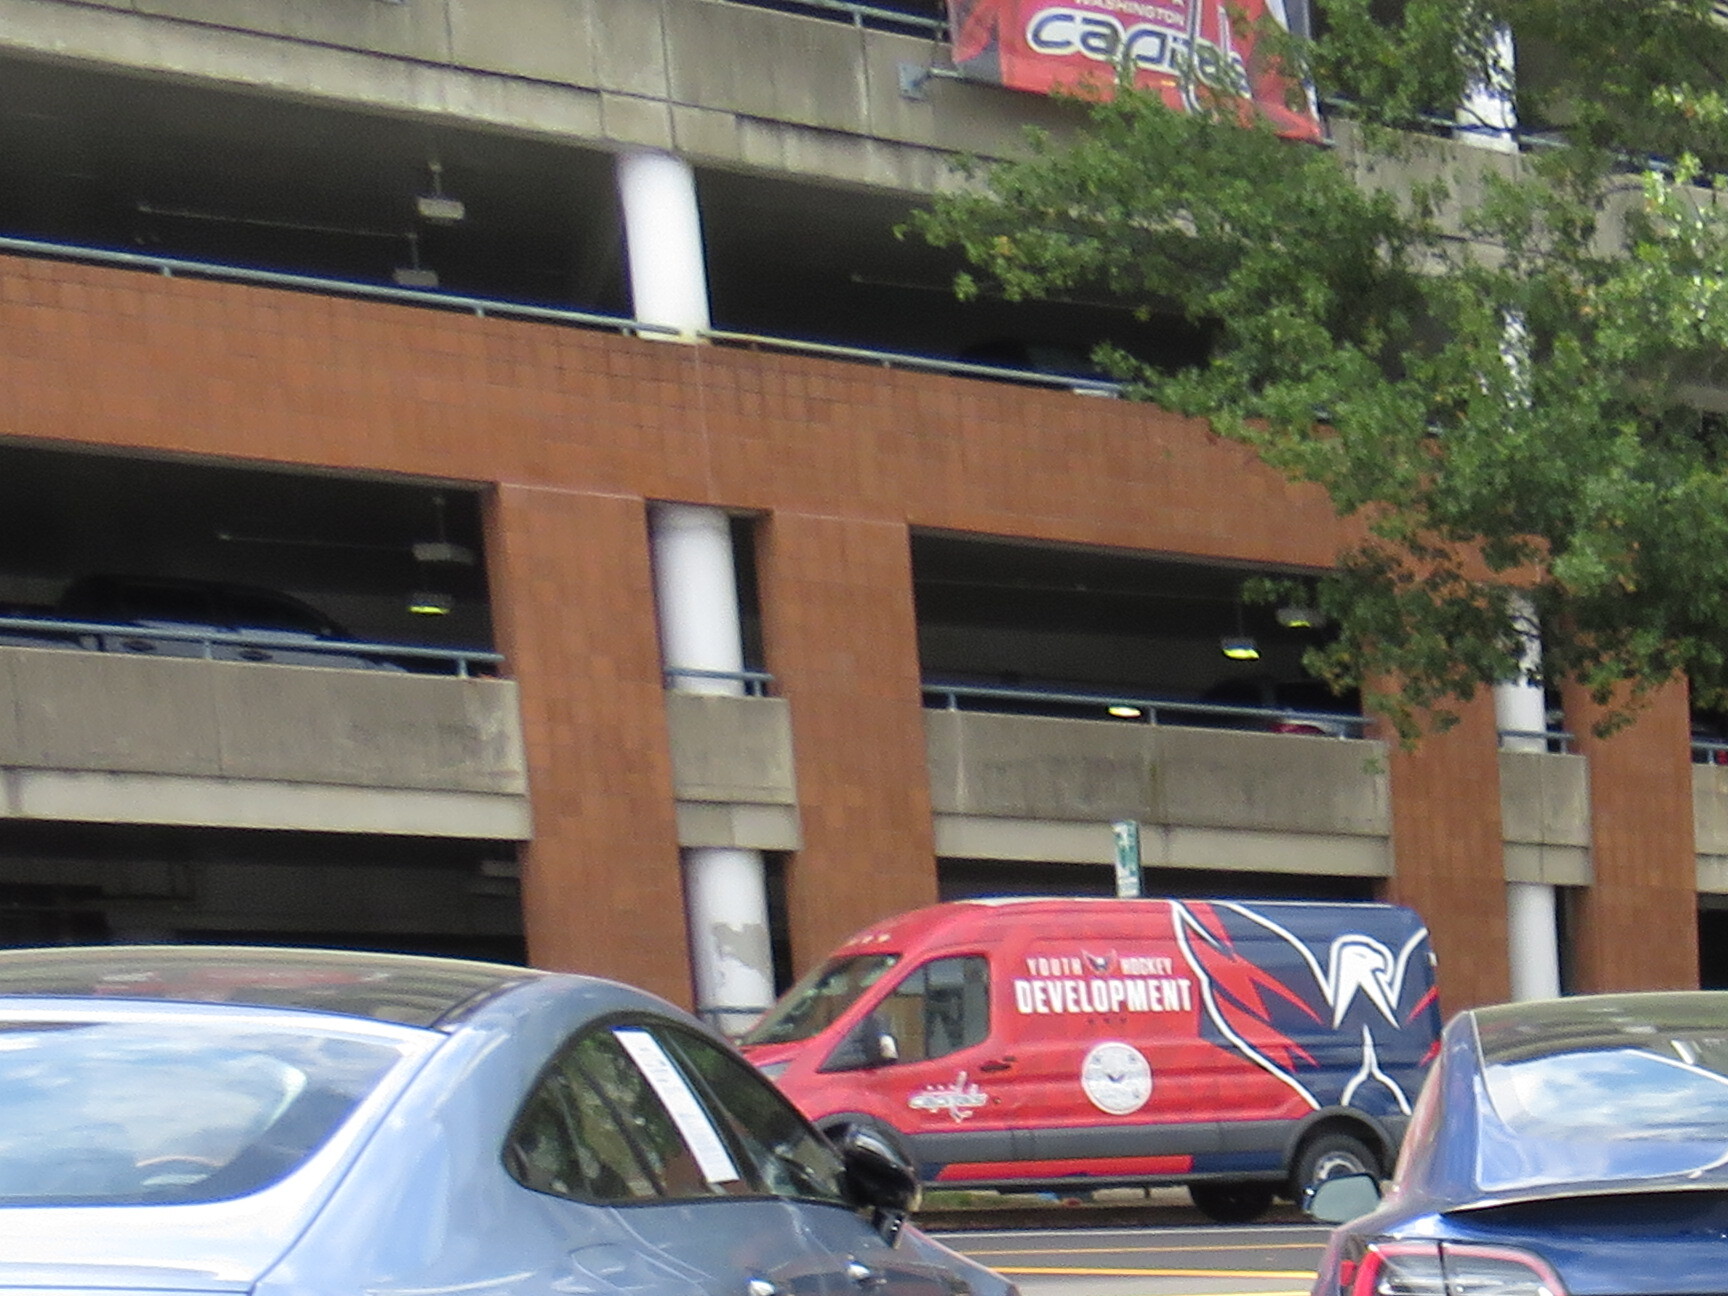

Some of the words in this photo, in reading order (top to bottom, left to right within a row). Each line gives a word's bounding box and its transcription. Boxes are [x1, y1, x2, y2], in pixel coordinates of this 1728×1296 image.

[1073, 0, 1188, 26] SHINGTON
[1026, 957, 1083, 976] YOUTH
[1119, 957, 1173, 976] HOCKEY
[1014, 978, 1191, 1014] DEVELOPMENT
